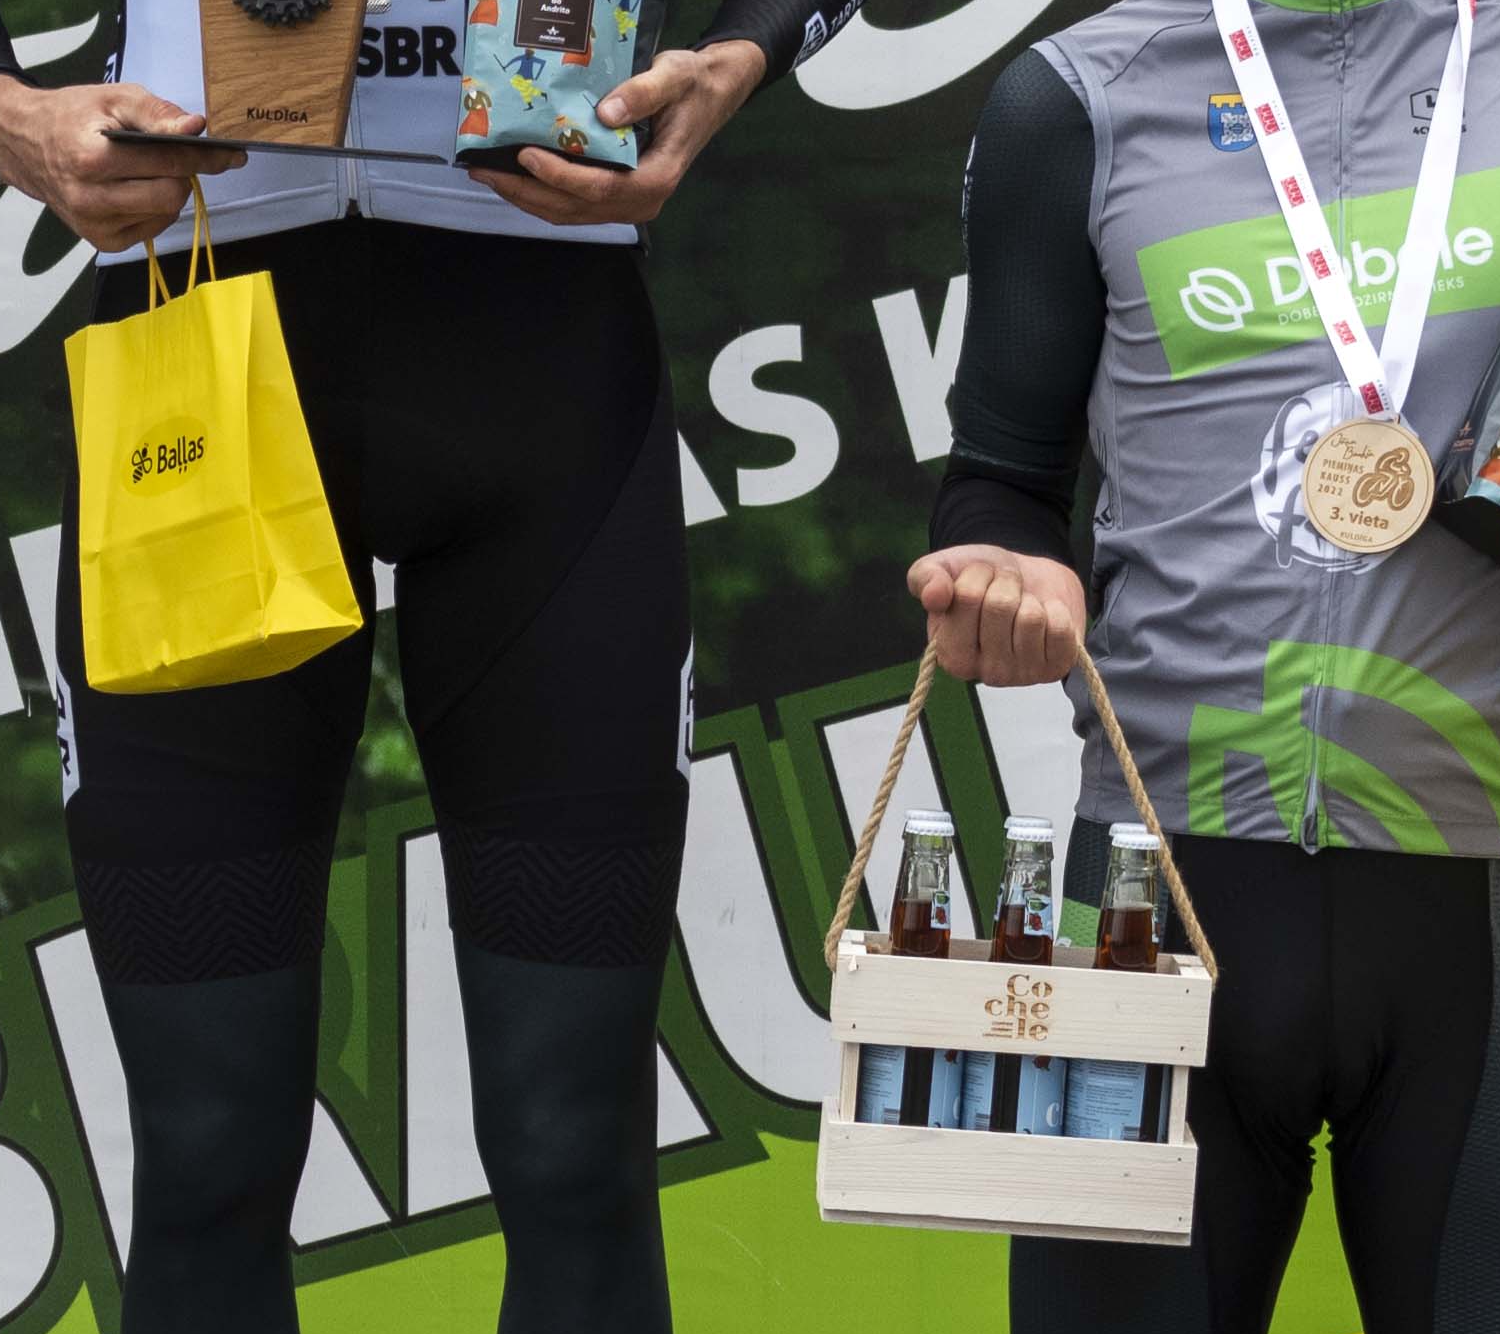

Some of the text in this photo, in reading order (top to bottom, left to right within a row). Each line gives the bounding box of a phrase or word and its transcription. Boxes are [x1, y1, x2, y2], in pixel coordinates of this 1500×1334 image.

[1317, 483, 1344, 497] 2022
[1320, 471, 1352, 485] KAUSS
[1329, 506, 1390, 530] 3. vieta
[1005, 972, 1054, 999] Co
[984, 994, 1050, 1021] che
